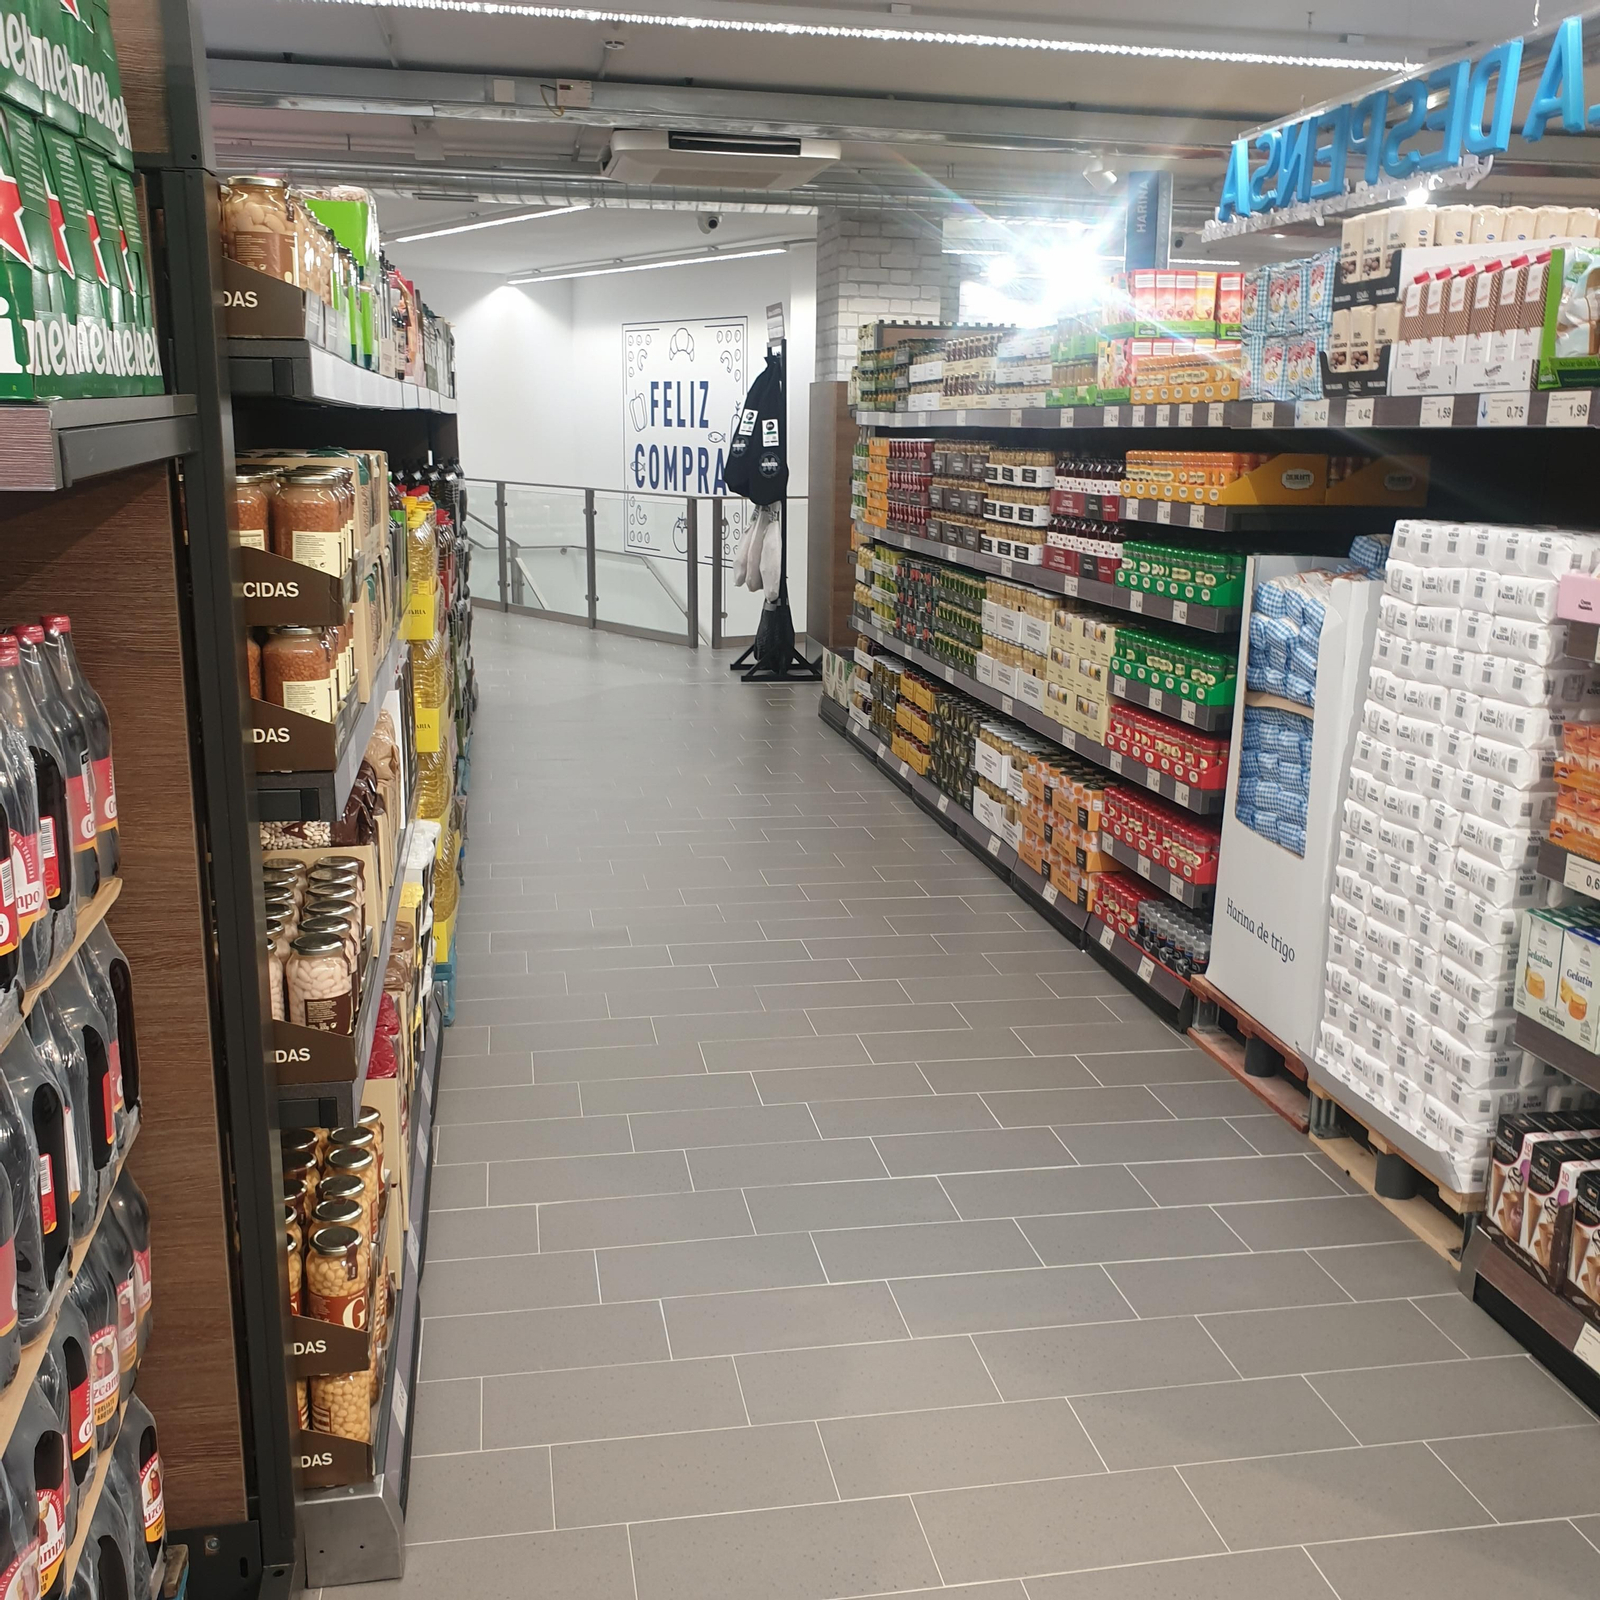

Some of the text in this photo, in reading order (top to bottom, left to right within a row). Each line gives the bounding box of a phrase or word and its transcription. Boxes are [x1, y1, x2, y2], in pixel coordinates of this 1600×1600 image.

[1136, 179, 1149, 233] HARINA
[650, 381, 709, 428] FELIZ
[1506, 406, 1524, 418] 0,75
[1569, 404, 1588, 417] 1,99
[634, 443, 727, 496] COMPRA
[242, 581, 299, 598] CIDAS
[252, 727, 291, 744] DAS
[1226, 897, 1295, 963] Harina de trigo
[1539, 1006, 1565, 1028] Gelatina
[275, 1047, 311, 1064] DAS
[293, 1339, 327, 1356] DAS
[301, 1452, 333, 1468] DAS
